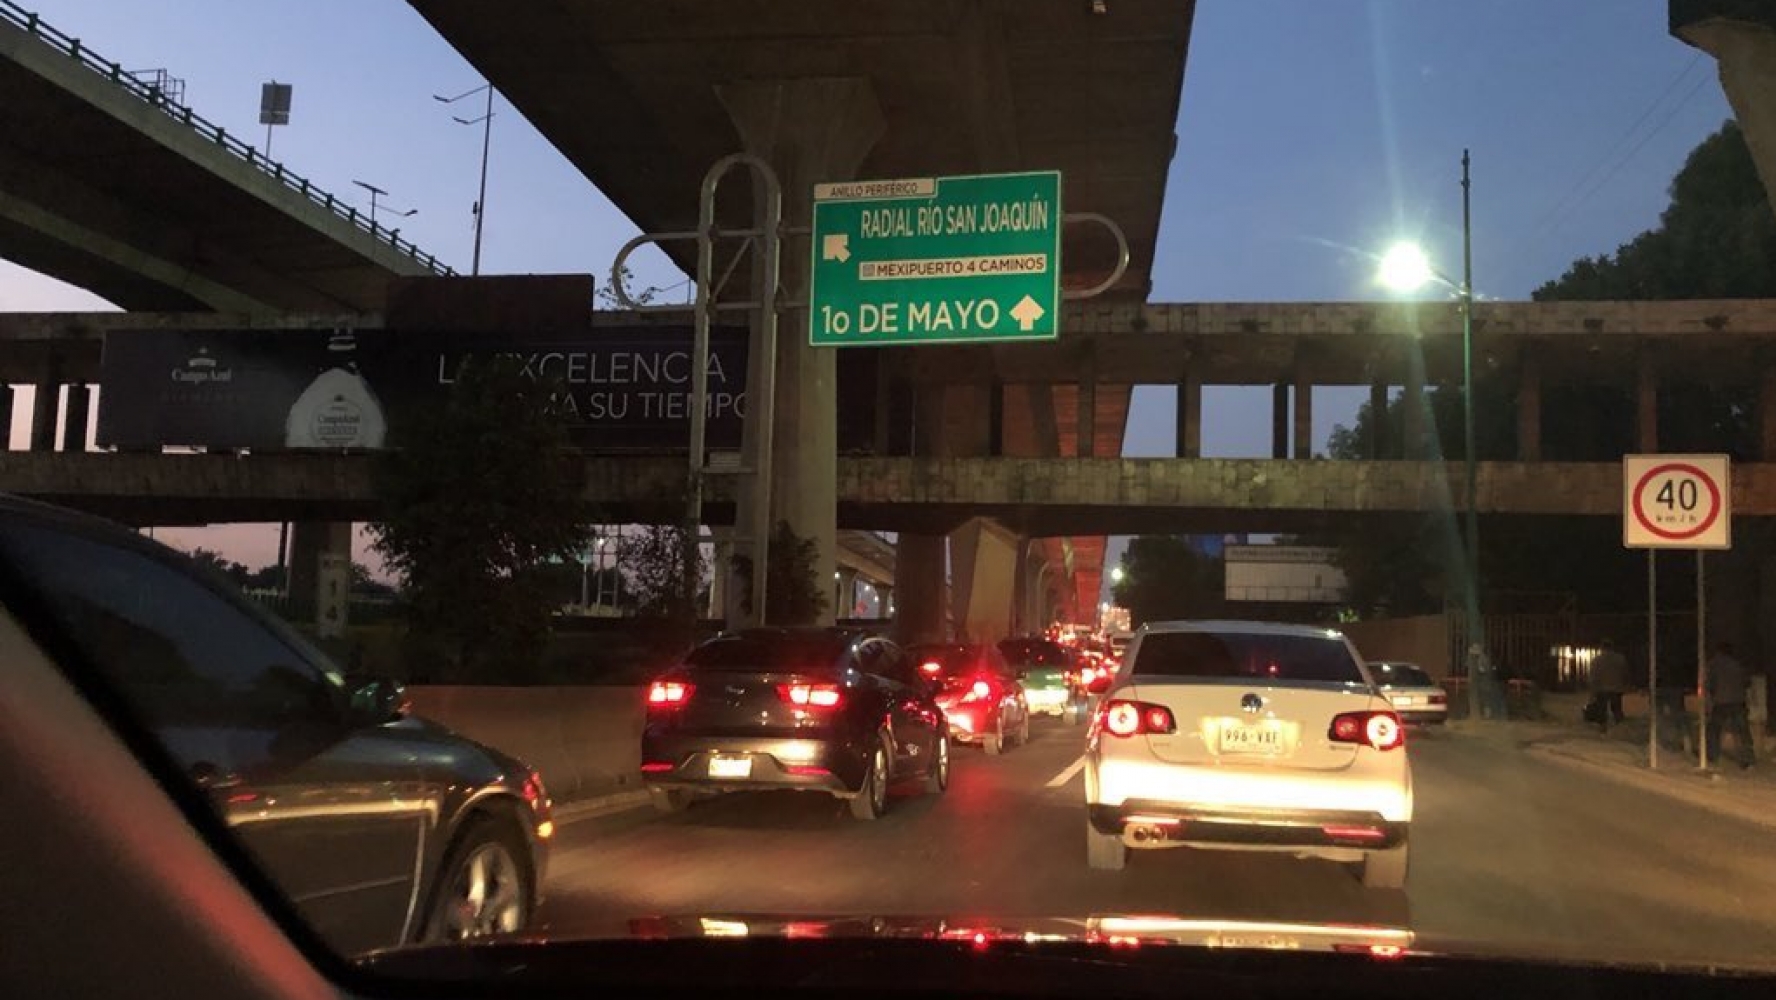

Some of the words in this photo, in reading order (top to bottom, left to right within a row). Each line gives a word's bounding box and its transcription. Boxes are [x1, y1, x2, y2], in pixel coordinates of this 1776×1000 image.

[830, 184, 863, 197] ANILLO
[861, 209, 913, 238] RADIAL
[917, 199, 943, 236] RÍO
[946, 204, 976, 234] SAN
[979, 194, 1048, 233] JOAQUÍN
[876, 260, 963, 276] MEXIPUERTO
[967, 261, 975, 272] 4
[979, 256, 1044, 272] CAMINOS
[859, 303, 898, 333] DE
[908, 298, 999, 332] MAYO
[495, 352, 727, 384] XCELENCA
[590, 393, 627, 418] SU
[1656, 479, 1698, 511] 40
